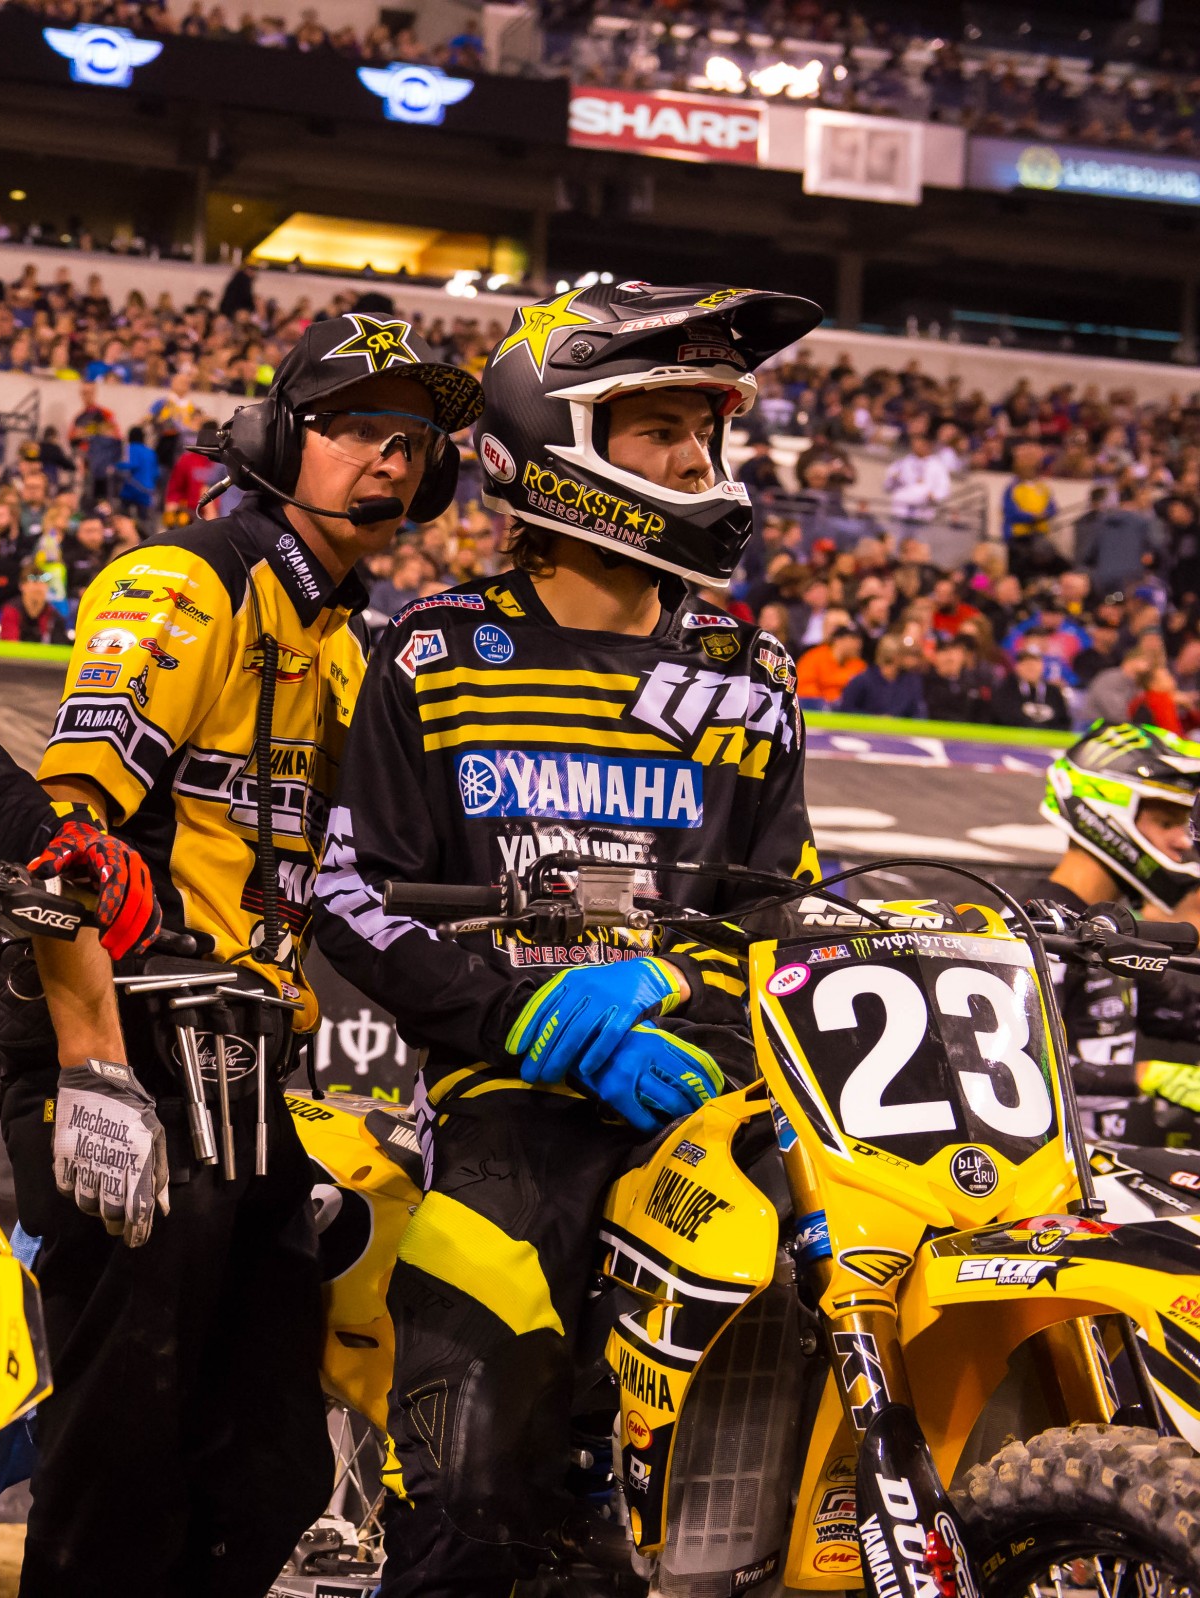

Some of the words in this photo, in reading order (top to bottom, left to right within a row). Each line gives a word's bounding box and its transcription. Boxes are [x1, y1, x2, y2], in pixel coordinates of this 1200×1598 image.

[568, 97, 759, 149] SHARP
[619, 315, 669, 332] FLEX
[679, 345, 737, 361] FLEX
[483, 441, 509, 476] BELL
[528, 492, 589, 528] ENERGY
[595, 518, 648, 549] DRINK
[286, 546, 321, 601] YAMAHA
[96, 611, 150, 622] BRAKING
[687, 614, 733, 626] AMA
[479, 630, 499, 643] bLU
[80, 668, 117, 681] GET
[74, 709, 129, 739] YAMAHA
[505, 757, 699, 821] YAMAHA
[12, 905, 82, 931] ARC
[457, 919, 490, 933] ARC
[872, 931, 967, 952] MONSTER
[513, 945, 599, 966] ENERGY
[806, 944, 852, 964] AMA
[892, 949, 957, 960] ENERGY
[1107, 954, 1170, 972] ARC
[777, 970, 802, 991] AMA
[811, 964, 1053, 1139] 23
[286, 1096, 335, 1122] NLOP
[69, 1103, 131, 1144] Mechanix
[387, 1123, 422, 1155] YAMA
[74, 1133, 140, 1173] Mechanix
[957, 1157, 982, 1176] bLU
[644, 1166, 731, 1244] YAMALUBE
[957, 1256, 1059, 1284] star
[997, 1275, 1037, 1285] RACING
[618, 1346, 676, 1413] YAMAHA
[628, 1419, 649, 1439] FMF
[816, 1523, 860, 1537] WORK
[816, 1533, 860, 1545] CONNECTI
[818, 1552, 860, 1566] FMF
[734, 1567, 763, 1587] Twin
